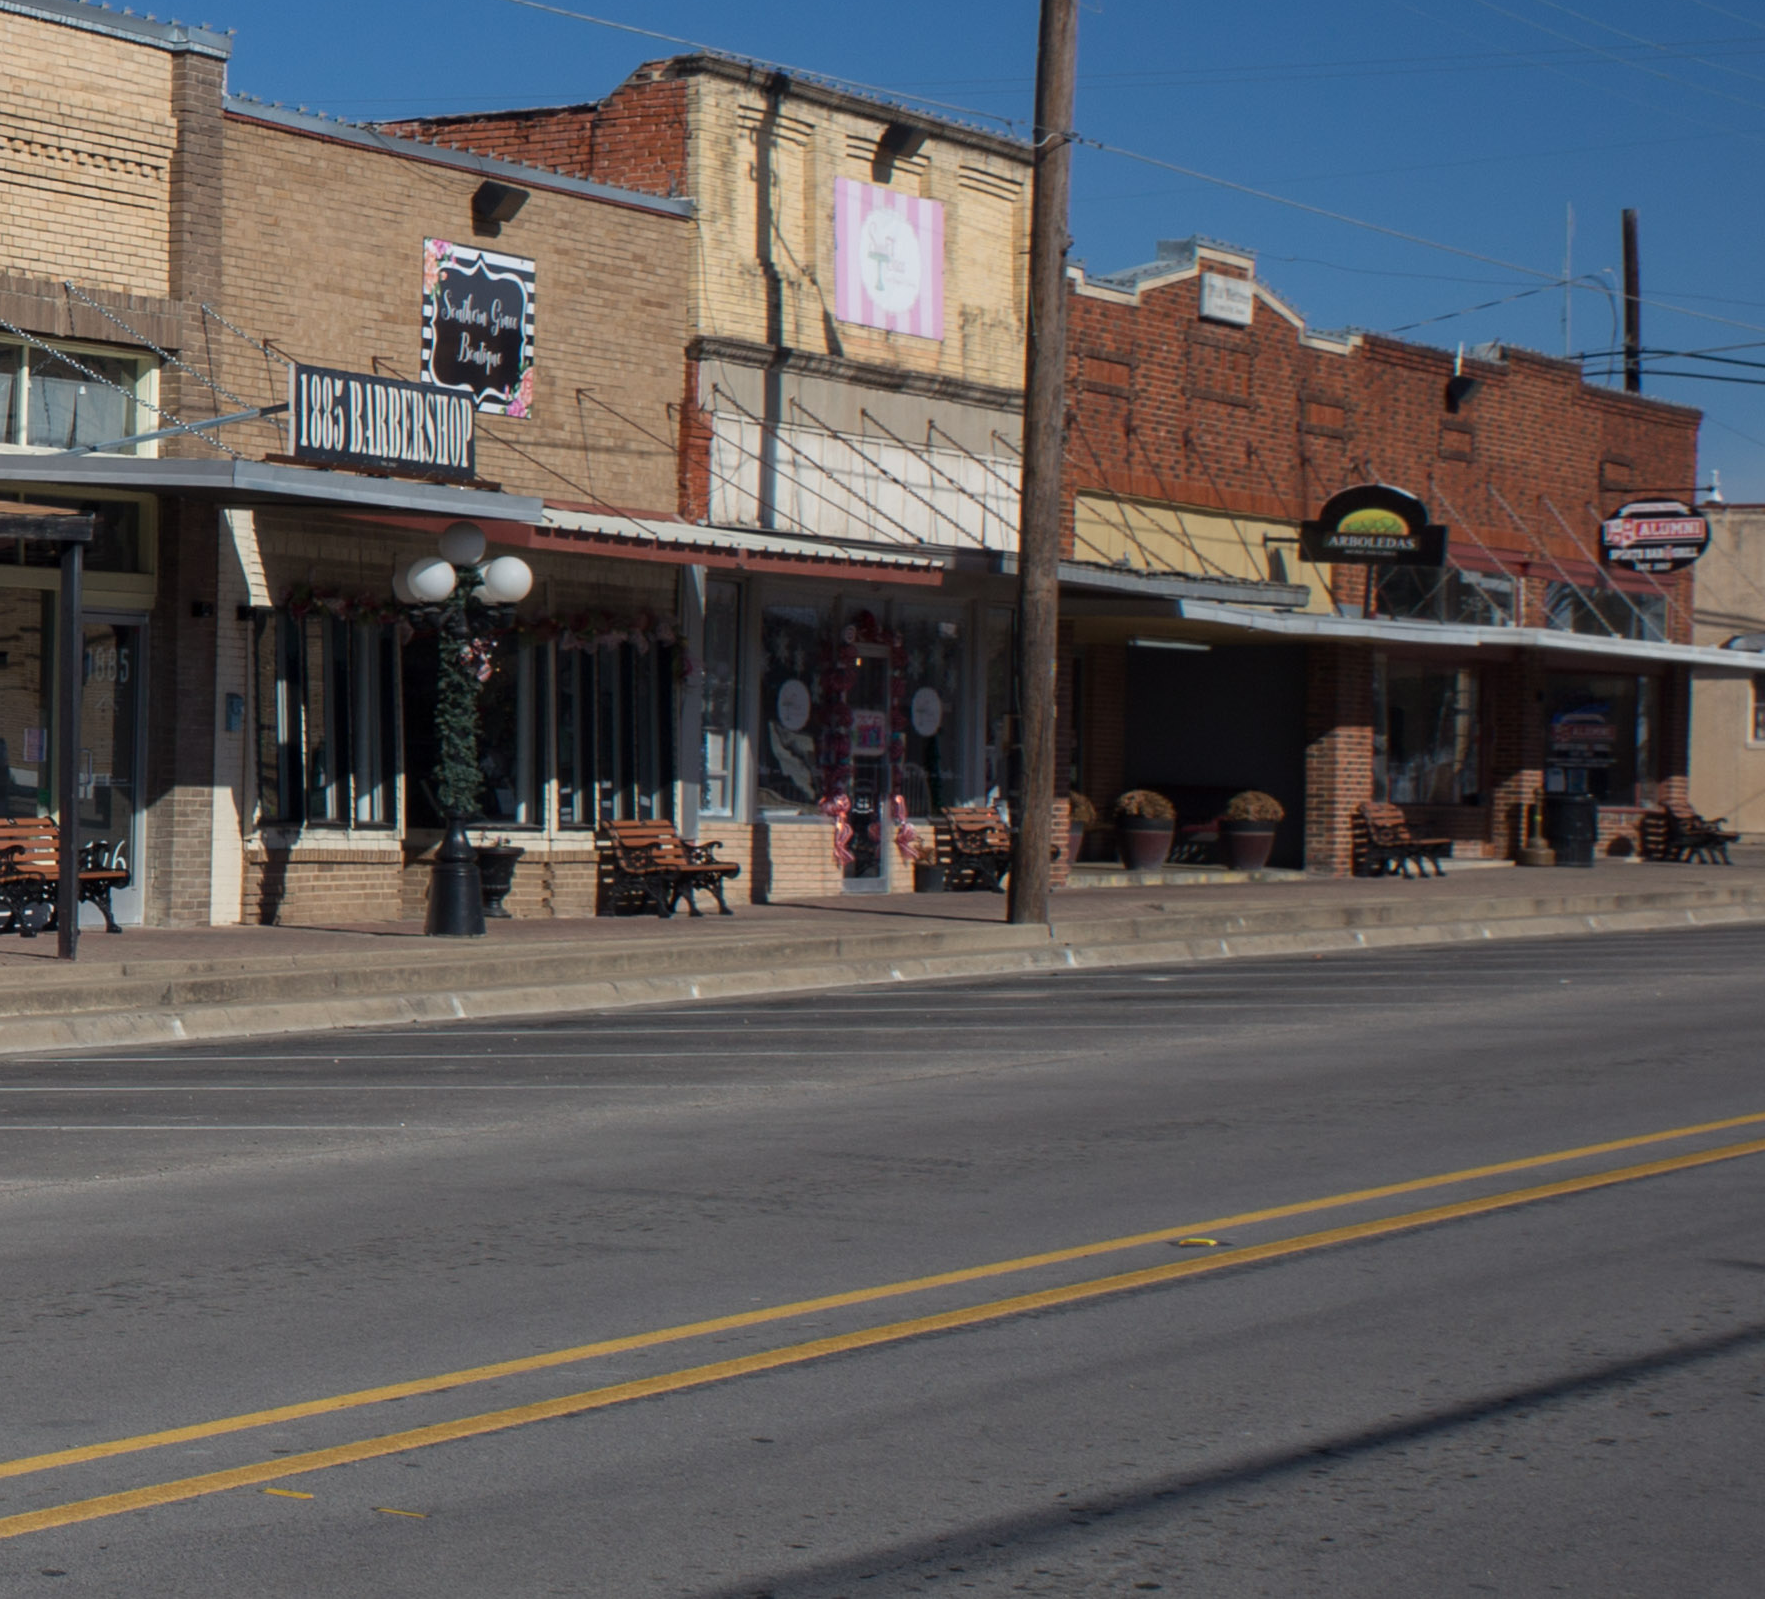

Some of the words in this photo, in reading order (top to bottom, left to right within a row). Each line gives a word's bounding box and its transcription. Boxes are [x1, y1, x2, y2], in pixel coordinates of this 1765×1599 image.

[441, 289, 488, 328] Southern
[489, 298, 519, 337] Grace
[457, 331, 503, 376] Boutique
[299, 372, 346, 452] 1885
[348, 379, 474, 468] BARBERSHOP
[1328, 534, 1417, 550] ARBOLEDAS
[1638, 521, 1702, 537] ALUMNI
